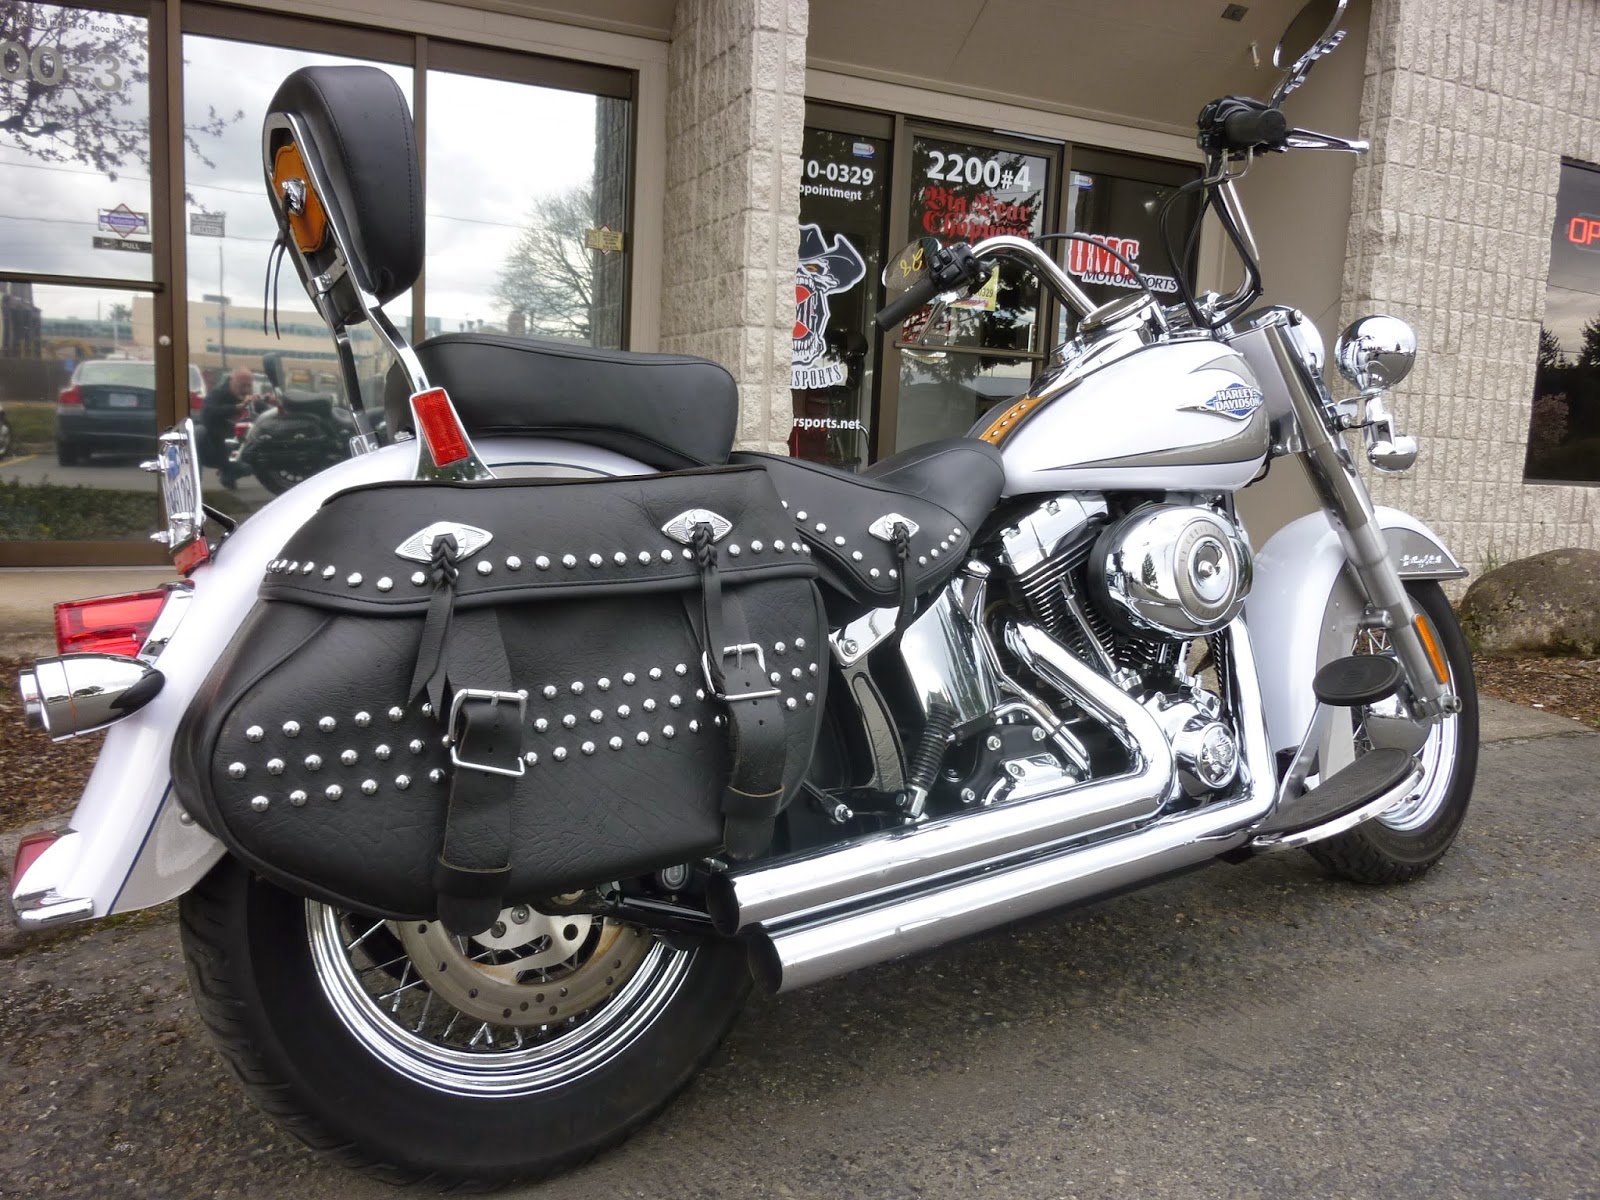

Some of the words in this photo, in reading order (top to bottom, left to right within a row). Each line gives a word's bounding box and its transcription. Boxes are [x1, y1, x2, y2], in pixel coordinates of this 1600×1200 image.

[927, 150, 1031, 192] 2200#4
[121, 242, 140, 250] PULL
[792, 364, 842, 387] SPORTS
[1214, 397, 1261, 412] DAVIDSON
